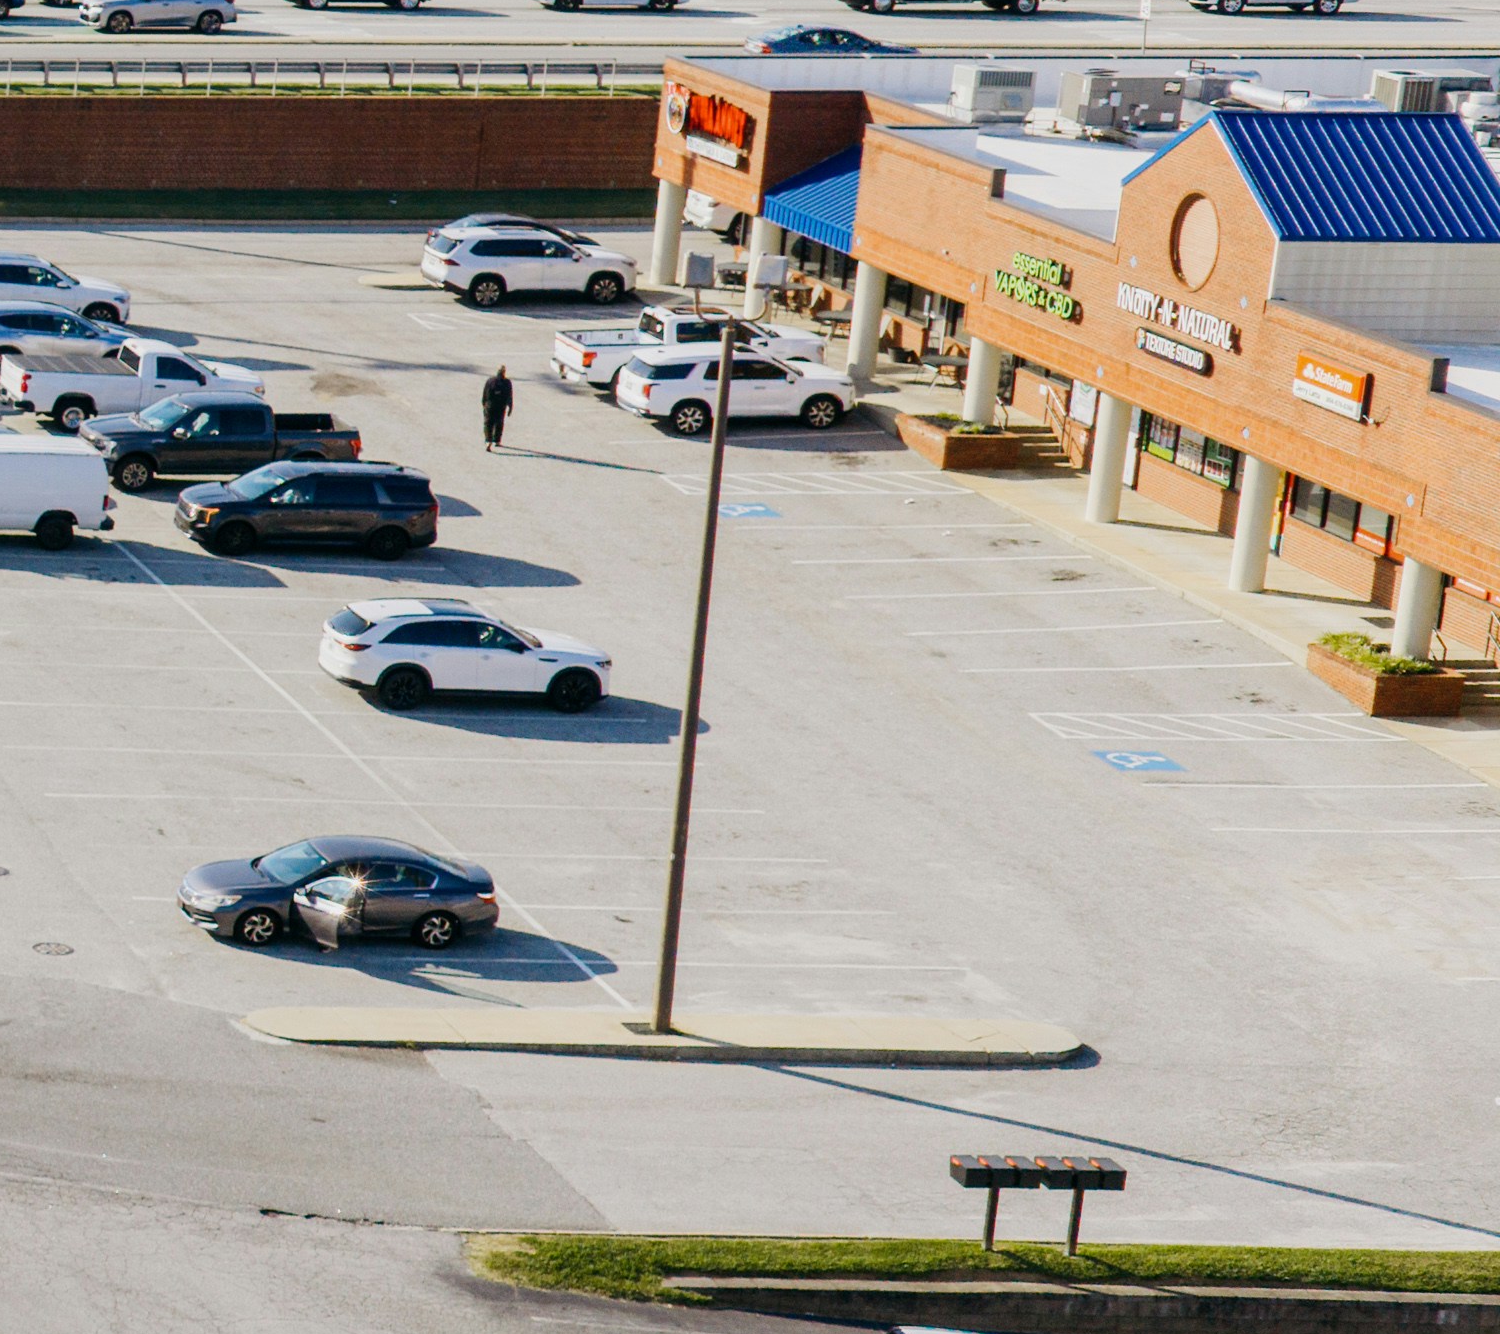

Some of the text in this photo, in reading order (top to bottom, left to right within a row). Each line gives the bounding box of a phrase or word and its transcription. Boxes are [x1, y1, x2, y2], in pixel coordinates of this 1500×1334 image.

[1013, 251, 1062, 286] essential
[995, 270, 1073, 319] VAPORS & CBD
[1145, 331, 1204, 370] TEXTURE STUDIO
